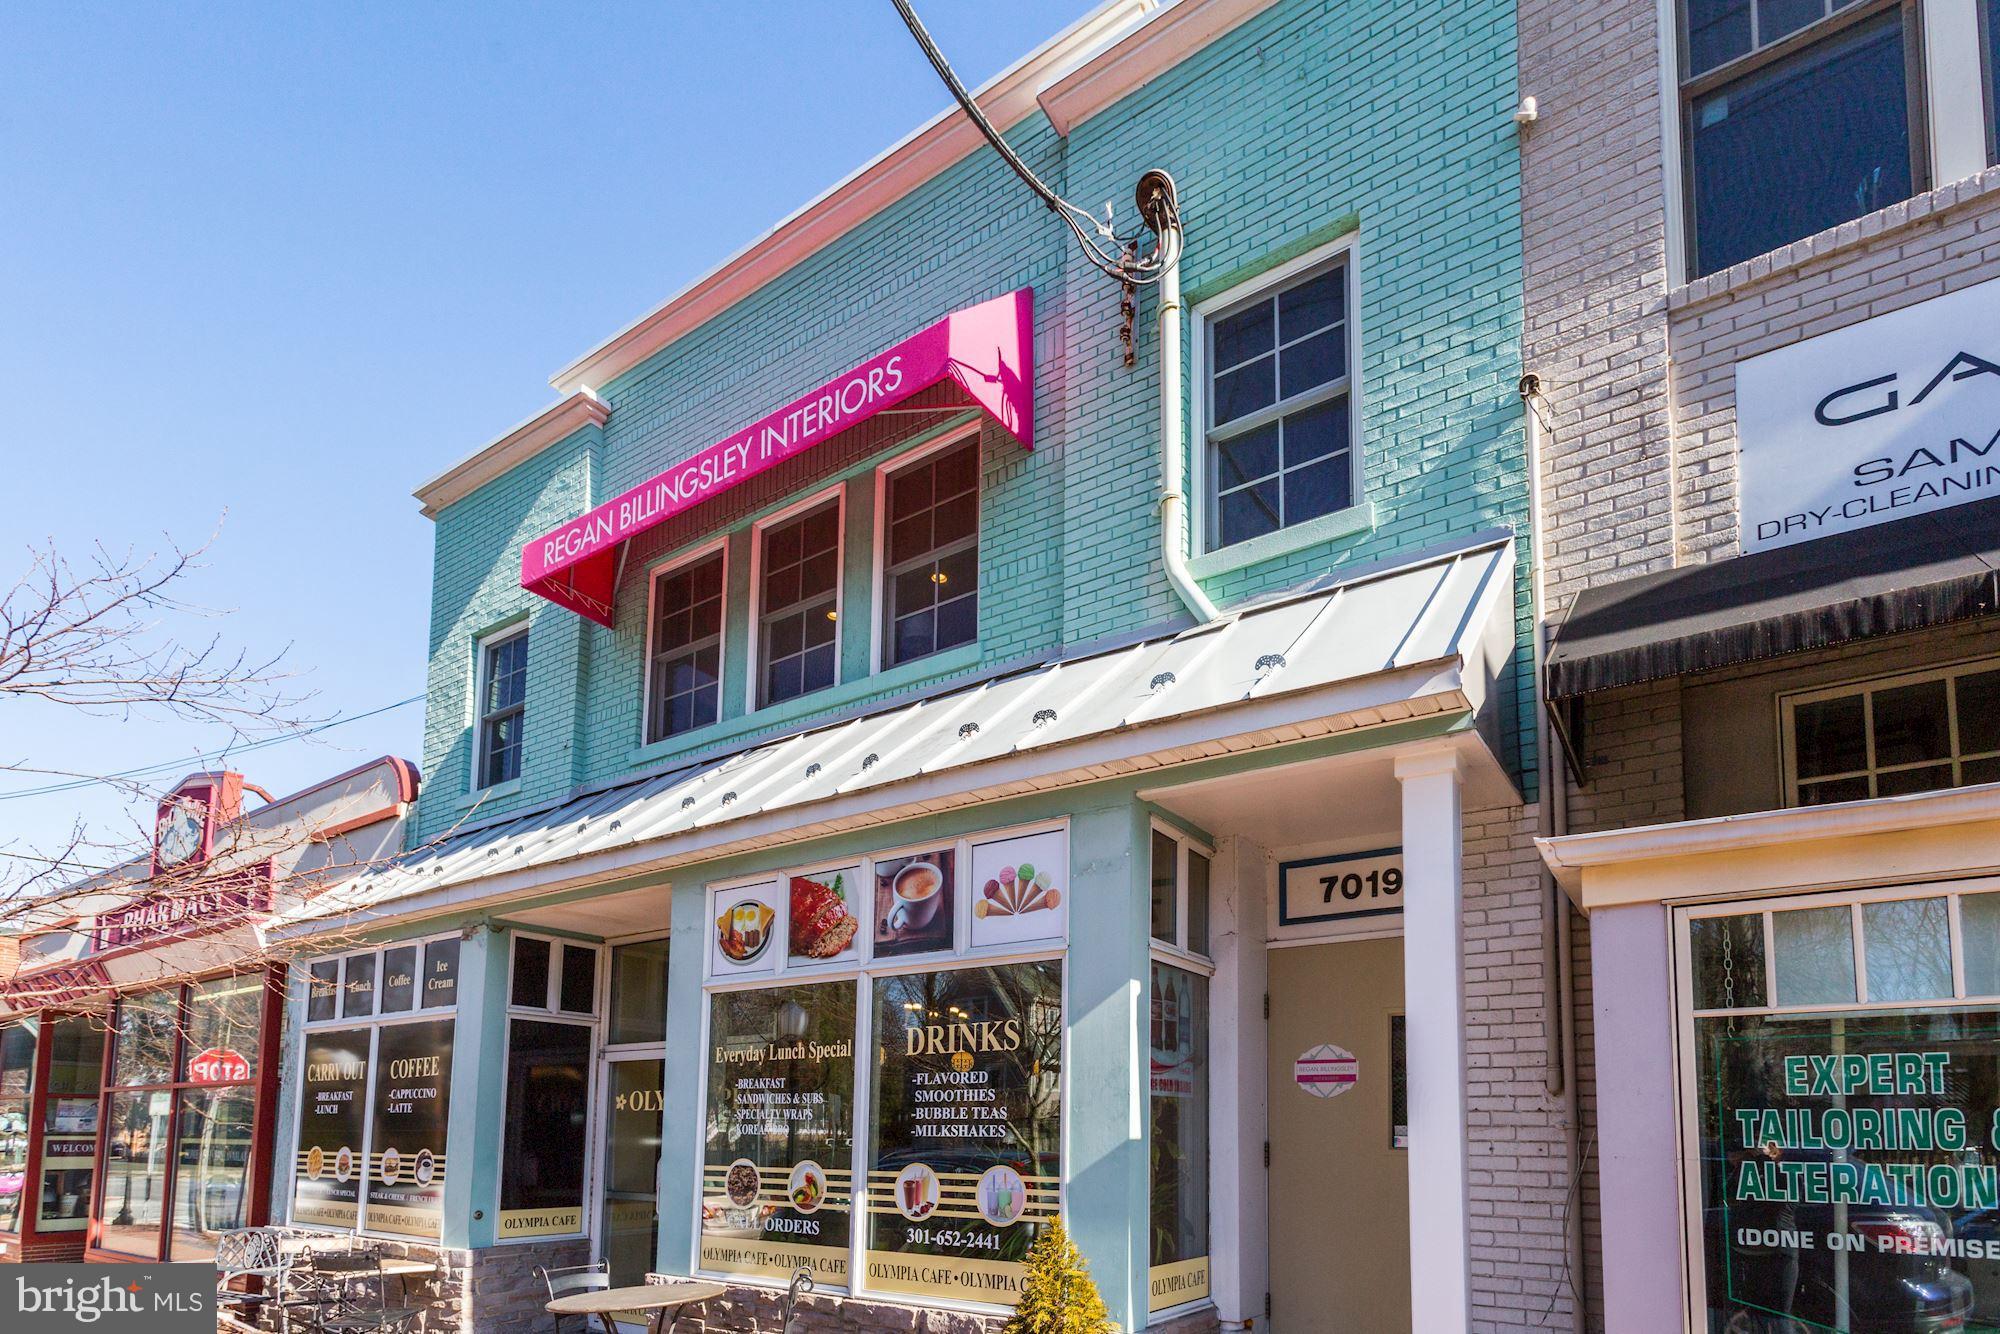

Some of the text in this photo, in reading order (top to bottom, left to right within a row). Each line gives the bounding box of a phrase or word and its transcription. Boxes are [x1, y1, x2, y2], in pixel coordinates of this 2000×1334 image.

[543, 355, 903, 568] REGAN BILLINGSLEY INTERIORS
[1319, 867, 1403, 904] 7019
[437, 960, 449, 973] Ice
[388, 974, 412, 988] Coffee
[428, 978, 454, 990] Cream
[905, 1019, 1020, 1056] DRINKS
[715, 1039, 852, 1066] Everyday Lunch Special
[307, 1060, 366, 1082] CARRY OUT
[390, 1056, 440, 1080] COFFEE
[1784, 1052, 1950, 1096] EXPERT
[735, 1077, 786, 1090] -BREAKFAST
[911, 1071, 988, 1086] -FLAVORED
[316, 1090, 353, 1102] -BREAKFAST
[388, 1088, 437, 1100] -CAPPUCCINO
[734, 1093, 791, 1105] -SANDWICHES
[793, 1094, 800, 1105] &
[802, 1092, 824, 1104] SUBS
[914, 1089, 996, 1103] SMOOTHIES
[315, 1104, 339, 1115] -LUNCH
[387, 1102, 413, 1114] -LATTE
[733, 1108, 813, 1121] -SPECIALTY WRAPS
[911, 1106, 1008, 1120] -BUBBLE TEAS
[910, 1124, 1006, 1138] -MILKSHAKES
[1735, 1107, 1967, 1152] TAILORING
[1735, 1160, 1998, 1210] ALTERATION
[504, 1214, 577, 1230] OLYMPIA CAFE
[764, 1217, 820, 1236] ORDERS
[906, 1228, 1000, 1250] 301-652-2441
[1737, 1228, 2000, 1260] (DONE ON PREMISE
[703, 1246, 847, 1275] OLYMPIA CAFE OLYMPIA CAFE
[868, 1262, 919, 1282] OLYMPIA
[921, 1267, 952, 1285] CAFE
[961, 1270, 1017, 1292] OLYMPIA
[1151, 1269, 1206, 1297] OLYMPIA CAFE
